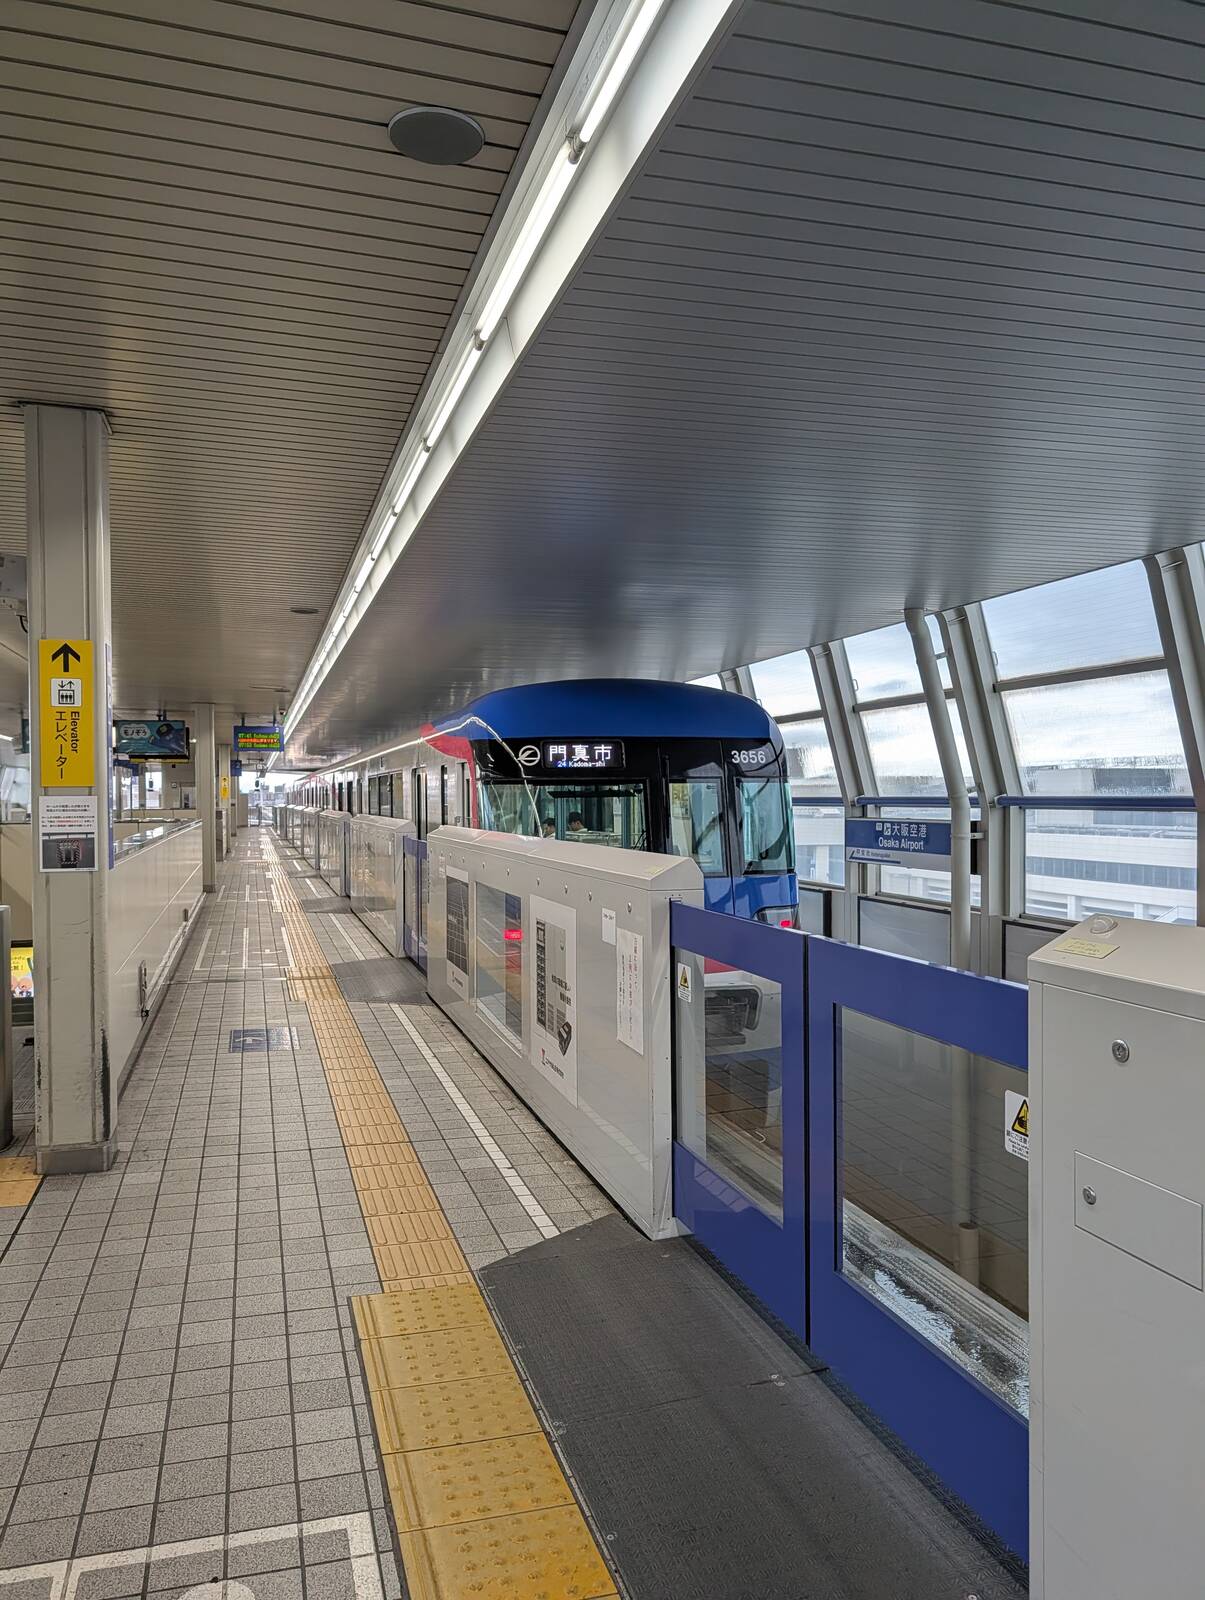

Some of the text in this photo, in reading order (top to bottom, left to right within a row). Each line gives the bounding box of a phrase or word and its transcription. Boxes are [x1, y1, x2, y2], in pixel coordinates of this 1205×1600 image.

[70, 711, 80, 753] Elevator
[55, 711, 68, 779] エレベーター
[549, 744, 612, 762] 門真市
[731, 750, 766, 764] 3656
[892, 823, 927, 838] 大阪空港
[878, 837, 924, 851] Osaka Airport
